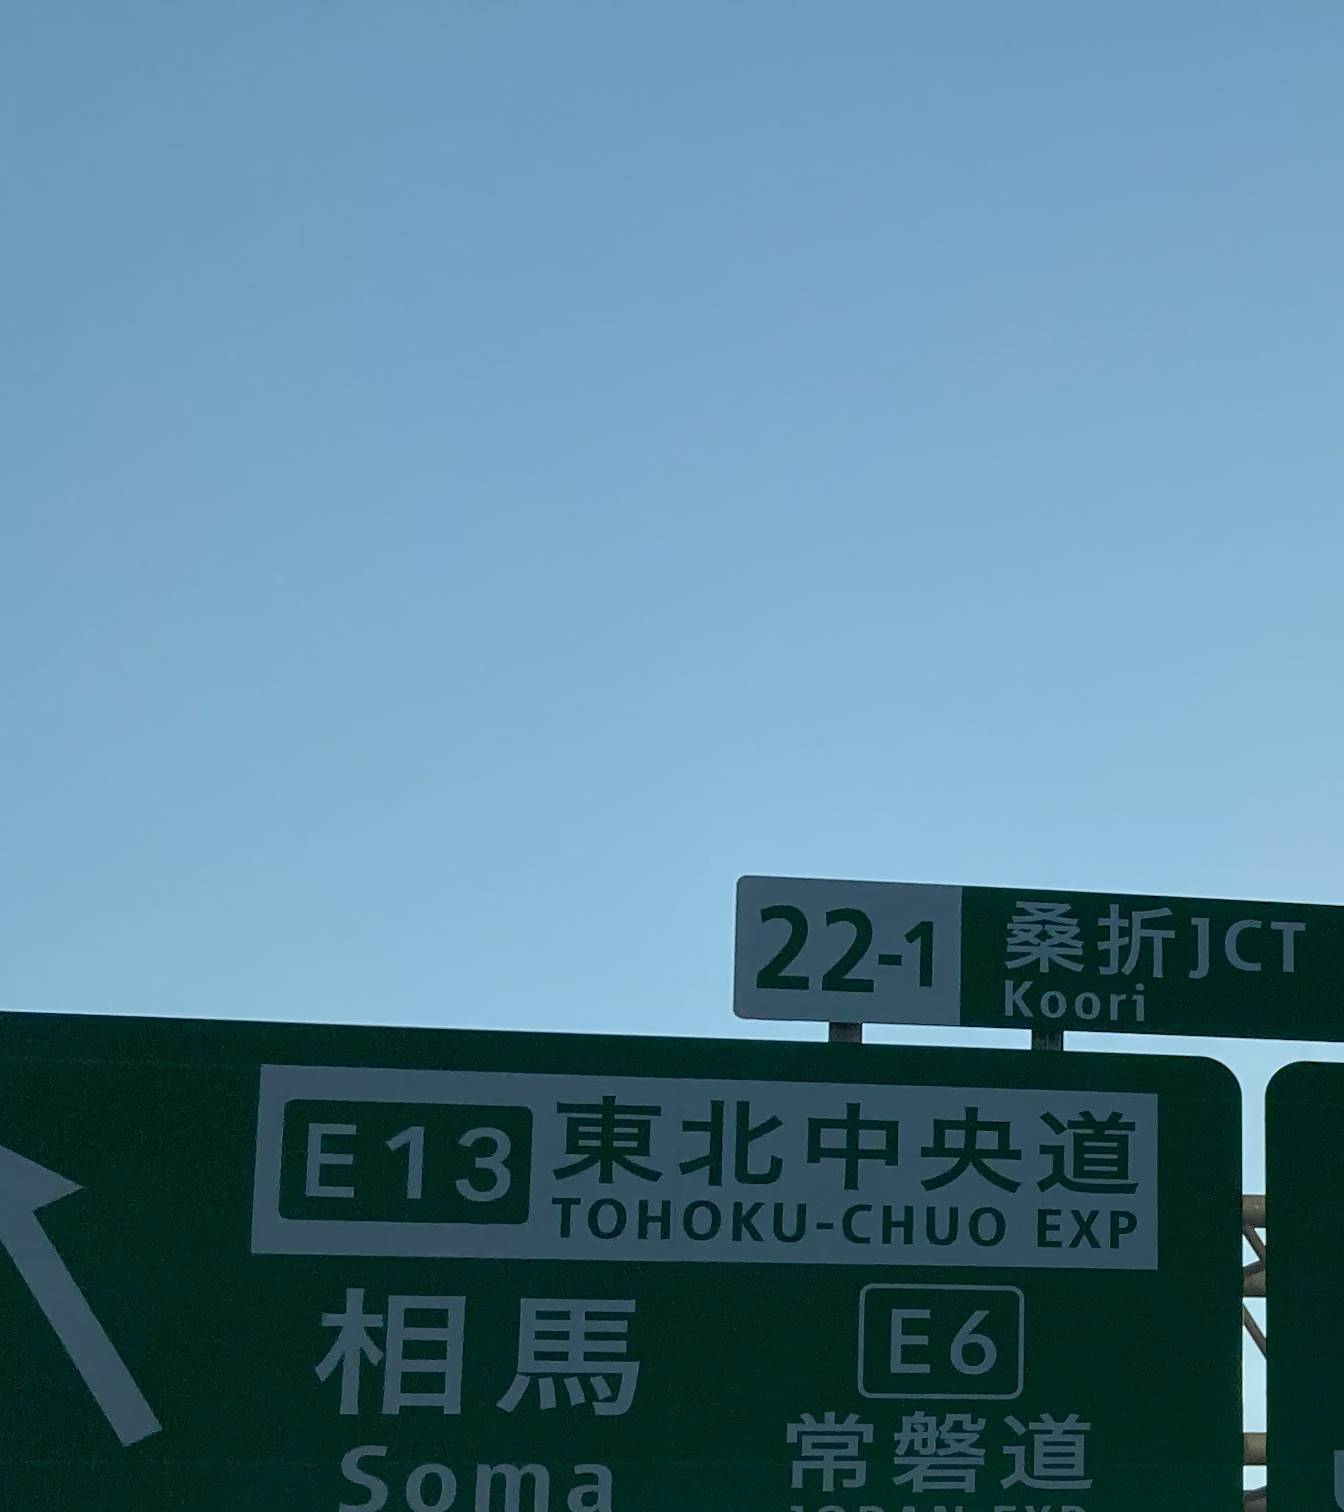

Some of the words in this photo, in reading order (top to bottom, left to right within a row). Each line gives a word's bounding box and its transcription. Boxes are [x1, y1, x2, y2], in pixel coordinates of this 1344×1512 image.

[757, 905, 933, 993] 22-1
[1004, 900, 1307, 979] 桑折JCT
[1004, 980, 1145, 1022] Koori
[305, 1123, 512, 1203] E13
[551, 1096, 1142, 1194] 東北中央道
[552, 1197, 1007, 1247] TOHOKU-CHUO
[1037, 1208, 1138, 1250] EXP
[315, 1288, 640, 1416] 相馬
[890, 1308, 998, 1376] E6
[785, 1410, 1093, 1493] 常磐道
